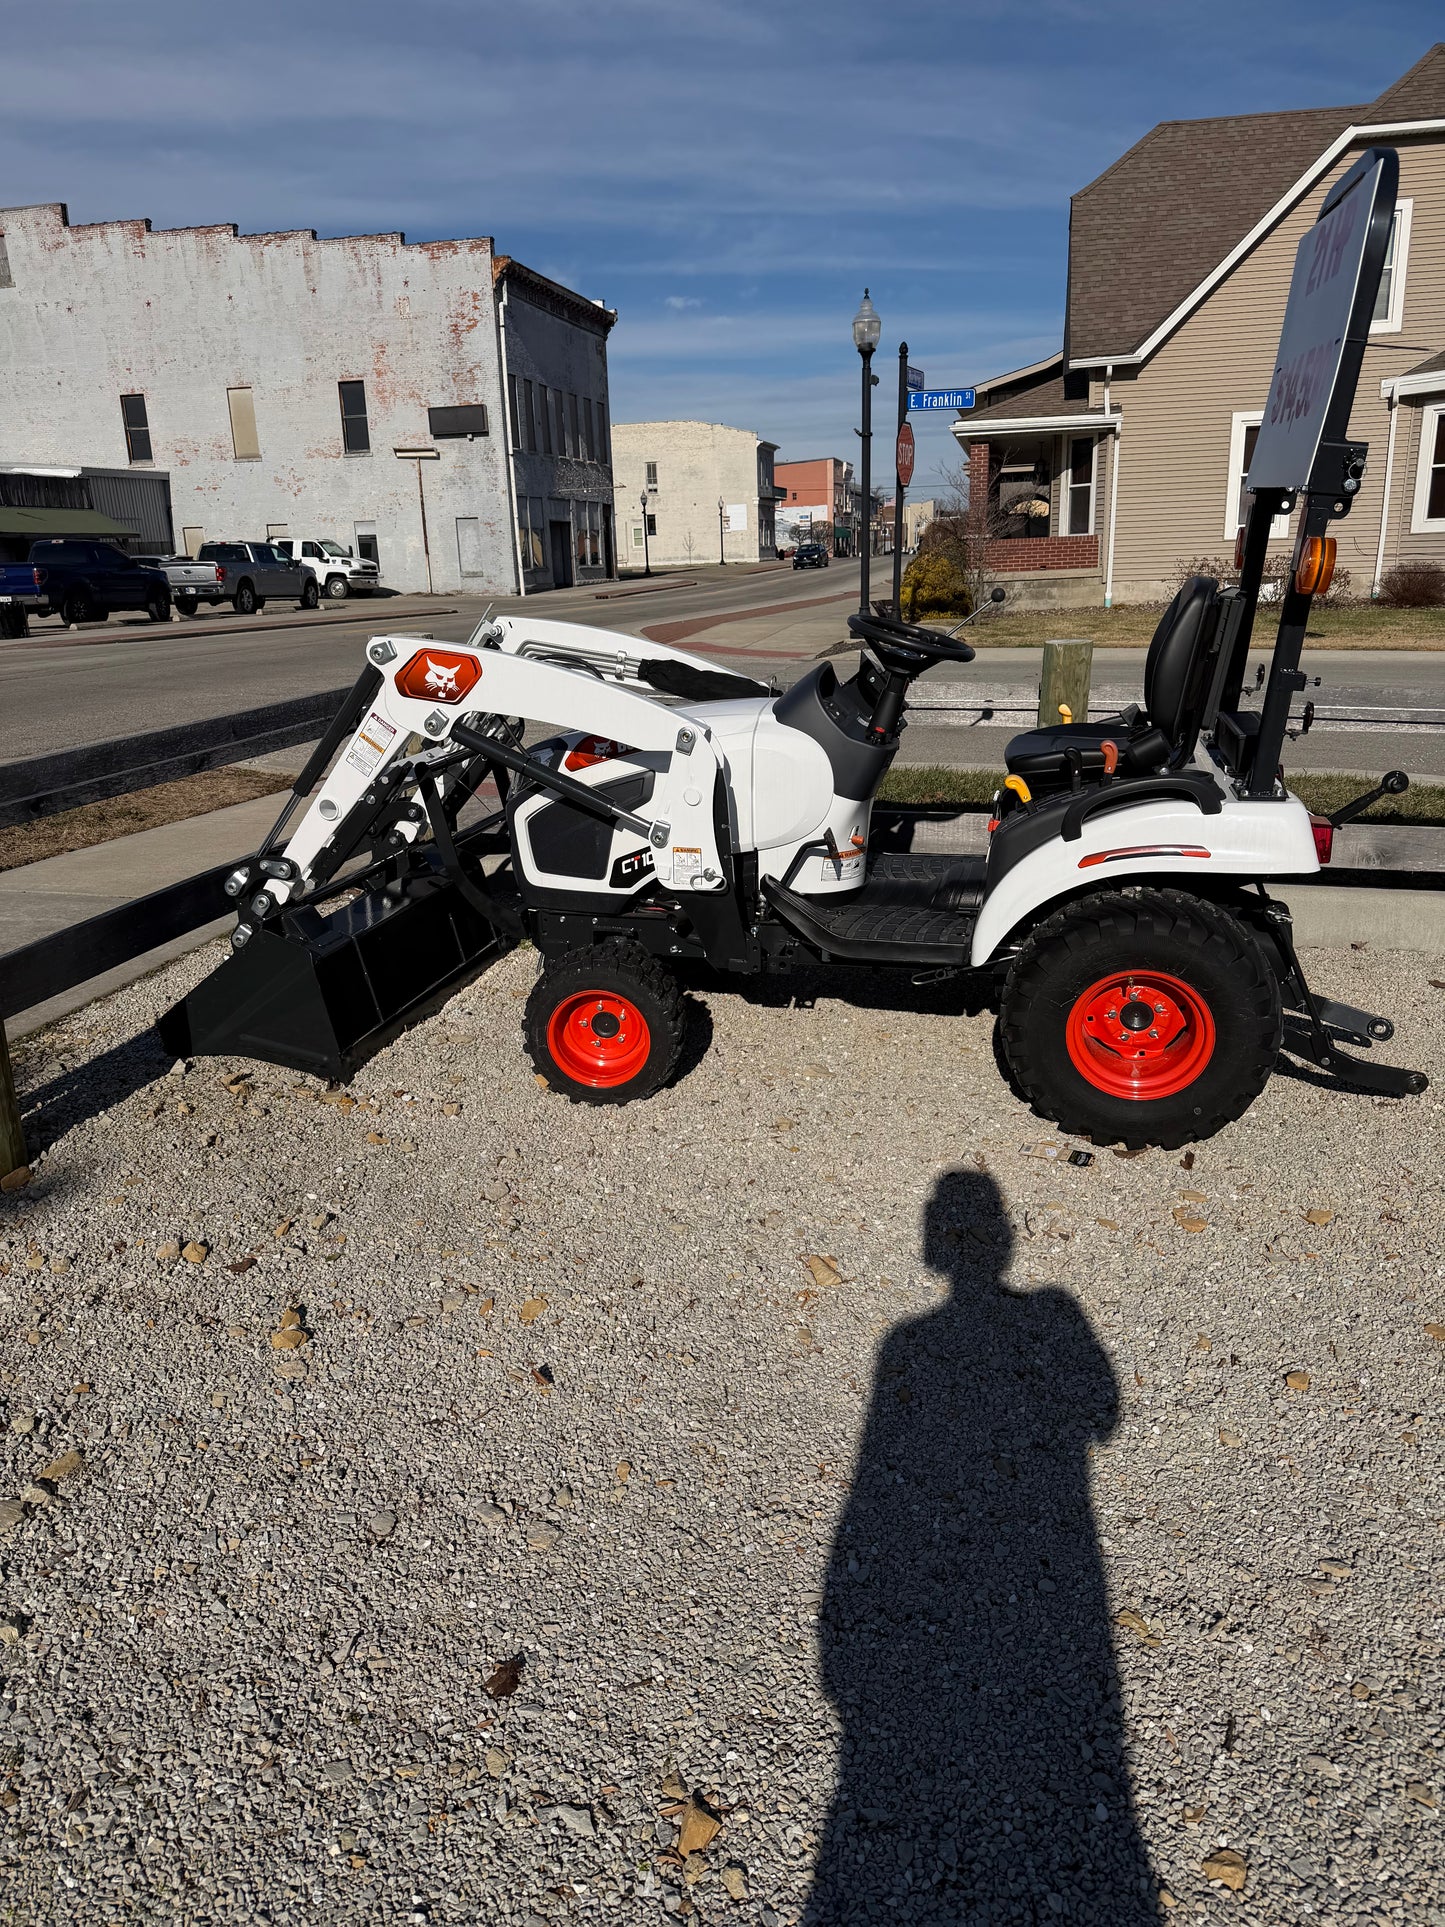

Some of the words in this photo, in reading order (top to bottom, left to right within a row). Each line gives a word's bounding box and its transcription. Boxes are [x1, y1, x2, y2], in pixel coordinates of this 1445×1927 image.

[1305, 214, 1336, 297] 21
[910, 394, 918, 408] E.
[923, 392, 962, 408] Franklin
[965, 391, 971, 399] St
[898, 443, 913, 465] STOP
